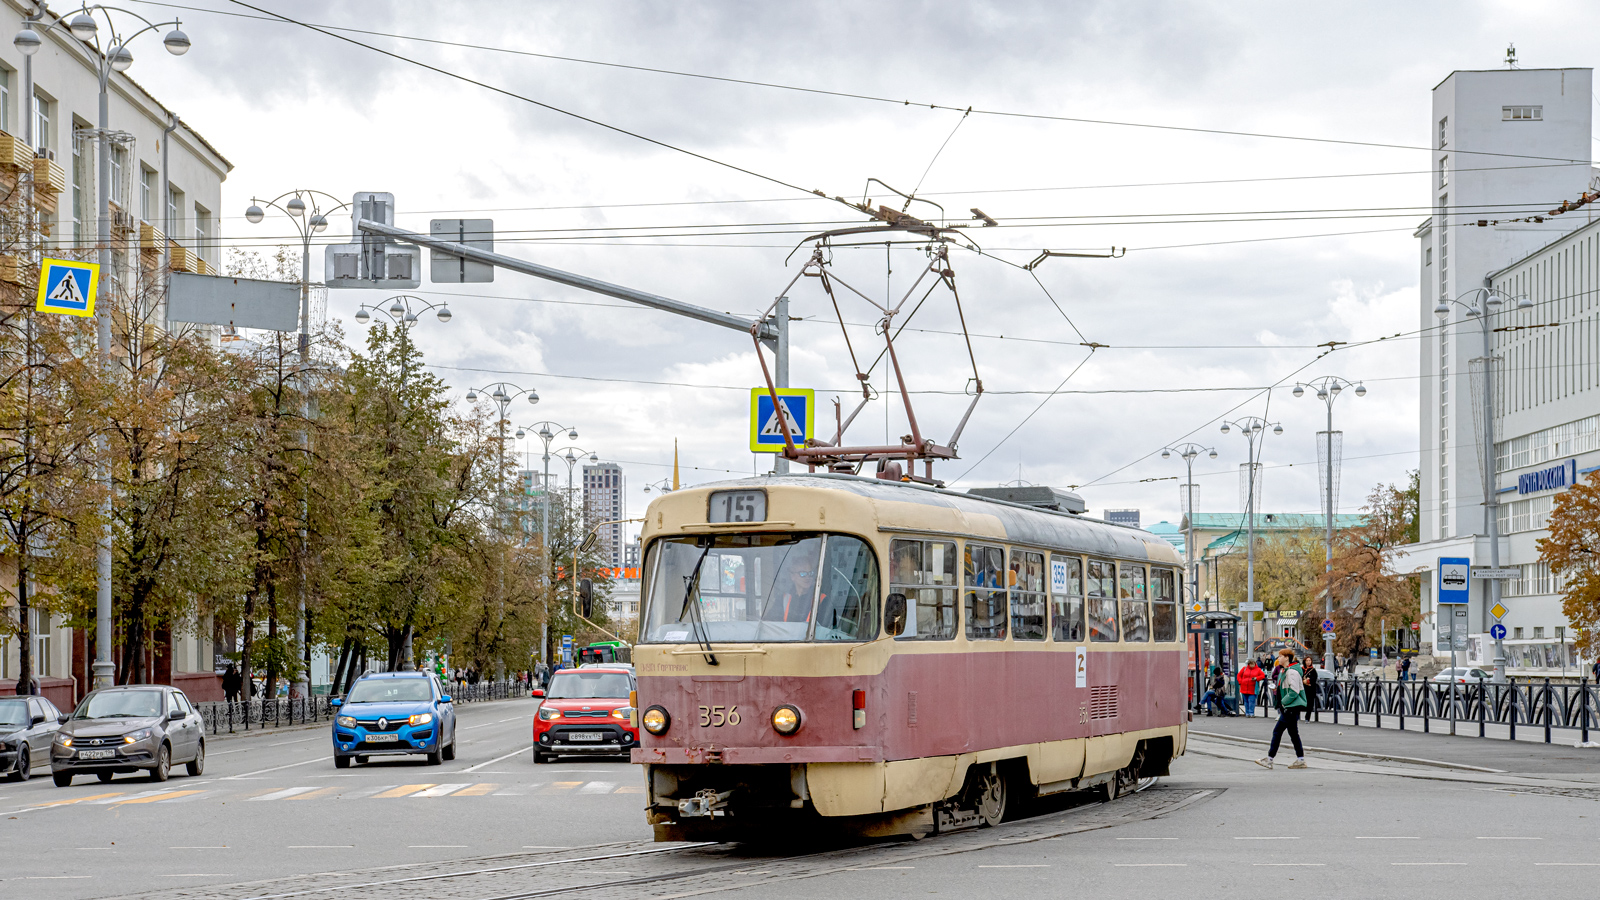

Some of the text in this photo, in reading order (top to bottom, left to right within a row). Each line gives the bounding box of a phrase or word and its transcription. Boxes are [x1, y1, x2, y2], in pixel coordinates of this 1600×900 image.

[1518, 465, 1565, 494] ПОЧТА РОССИИ
[722, 495, 754, 522] 15
[1053, 564, 1065, 584] 356
[1078, 654, 1084, 672] 2
[699, 705, 741, 727] 356
